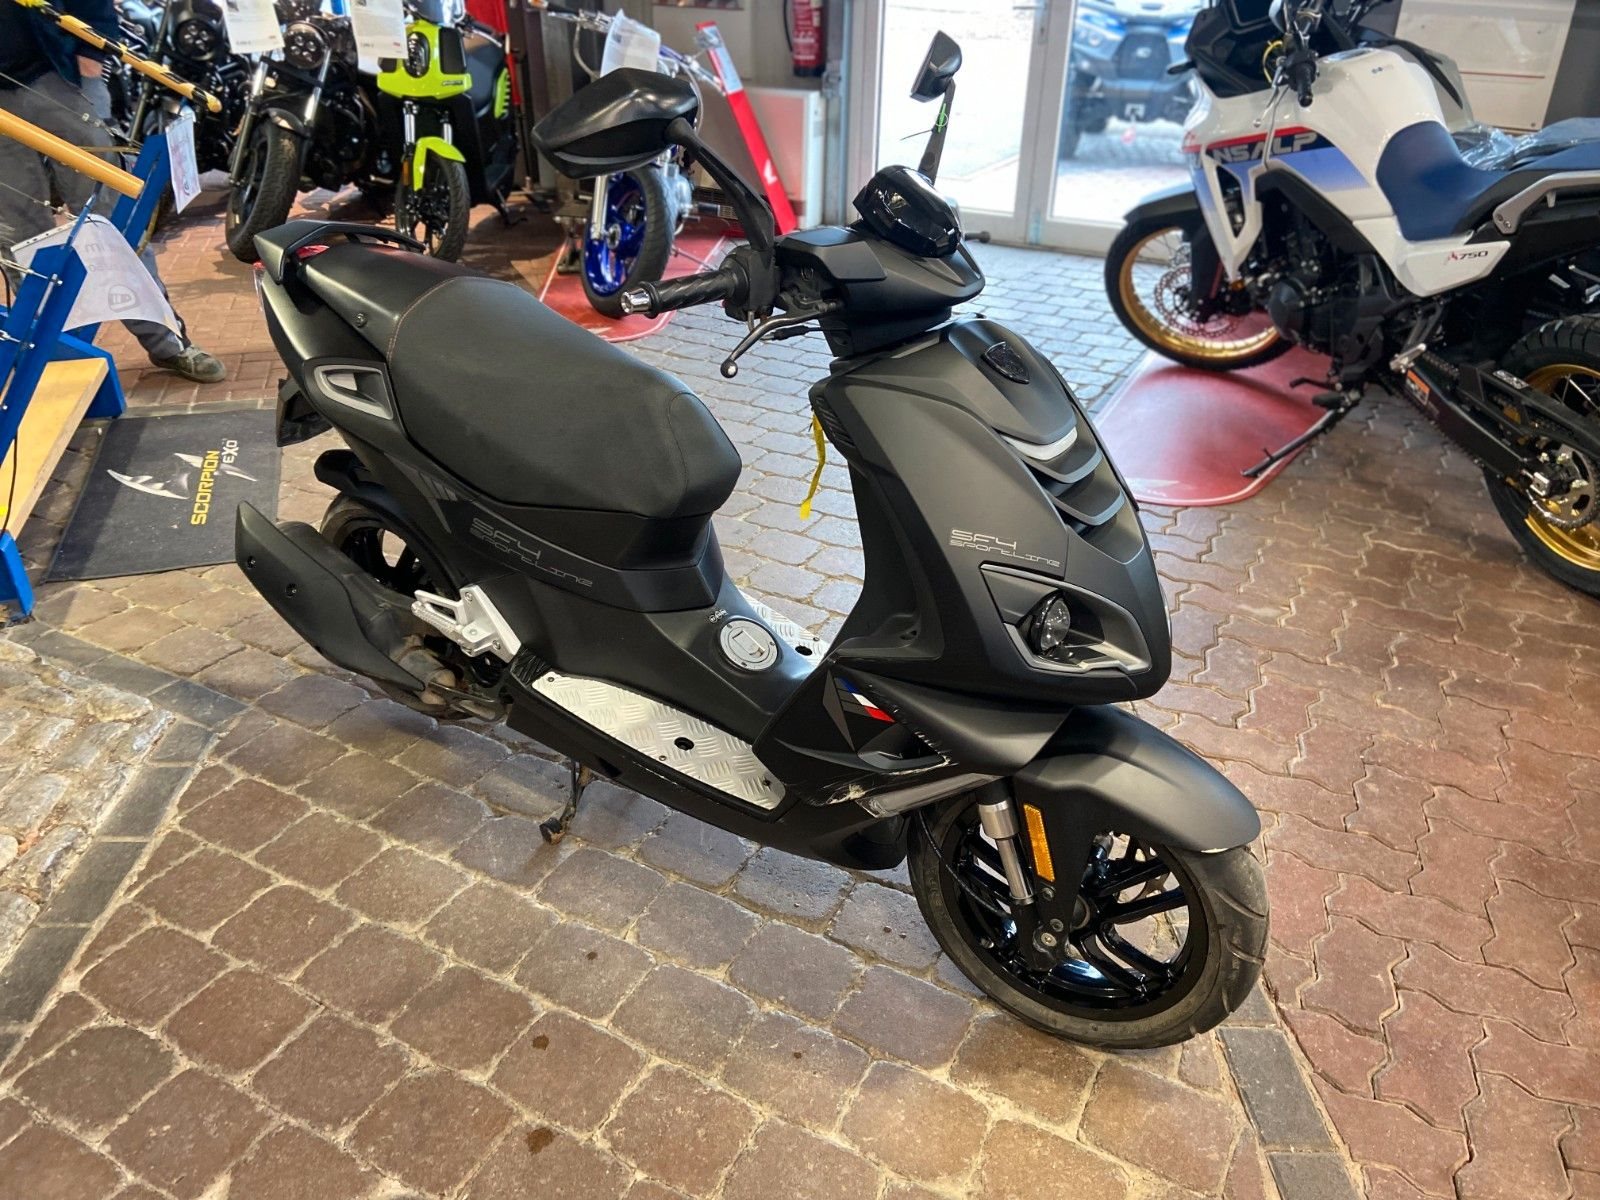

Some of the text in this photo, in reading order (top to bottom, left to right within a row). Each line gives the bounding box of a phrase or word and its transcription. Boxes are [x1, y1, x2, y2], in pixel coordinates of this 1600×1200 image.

[191, 450, 220, 525] SCORPION
[472, 517, 541, 559] SF4
[951, 529, 1017, 550] SF4
